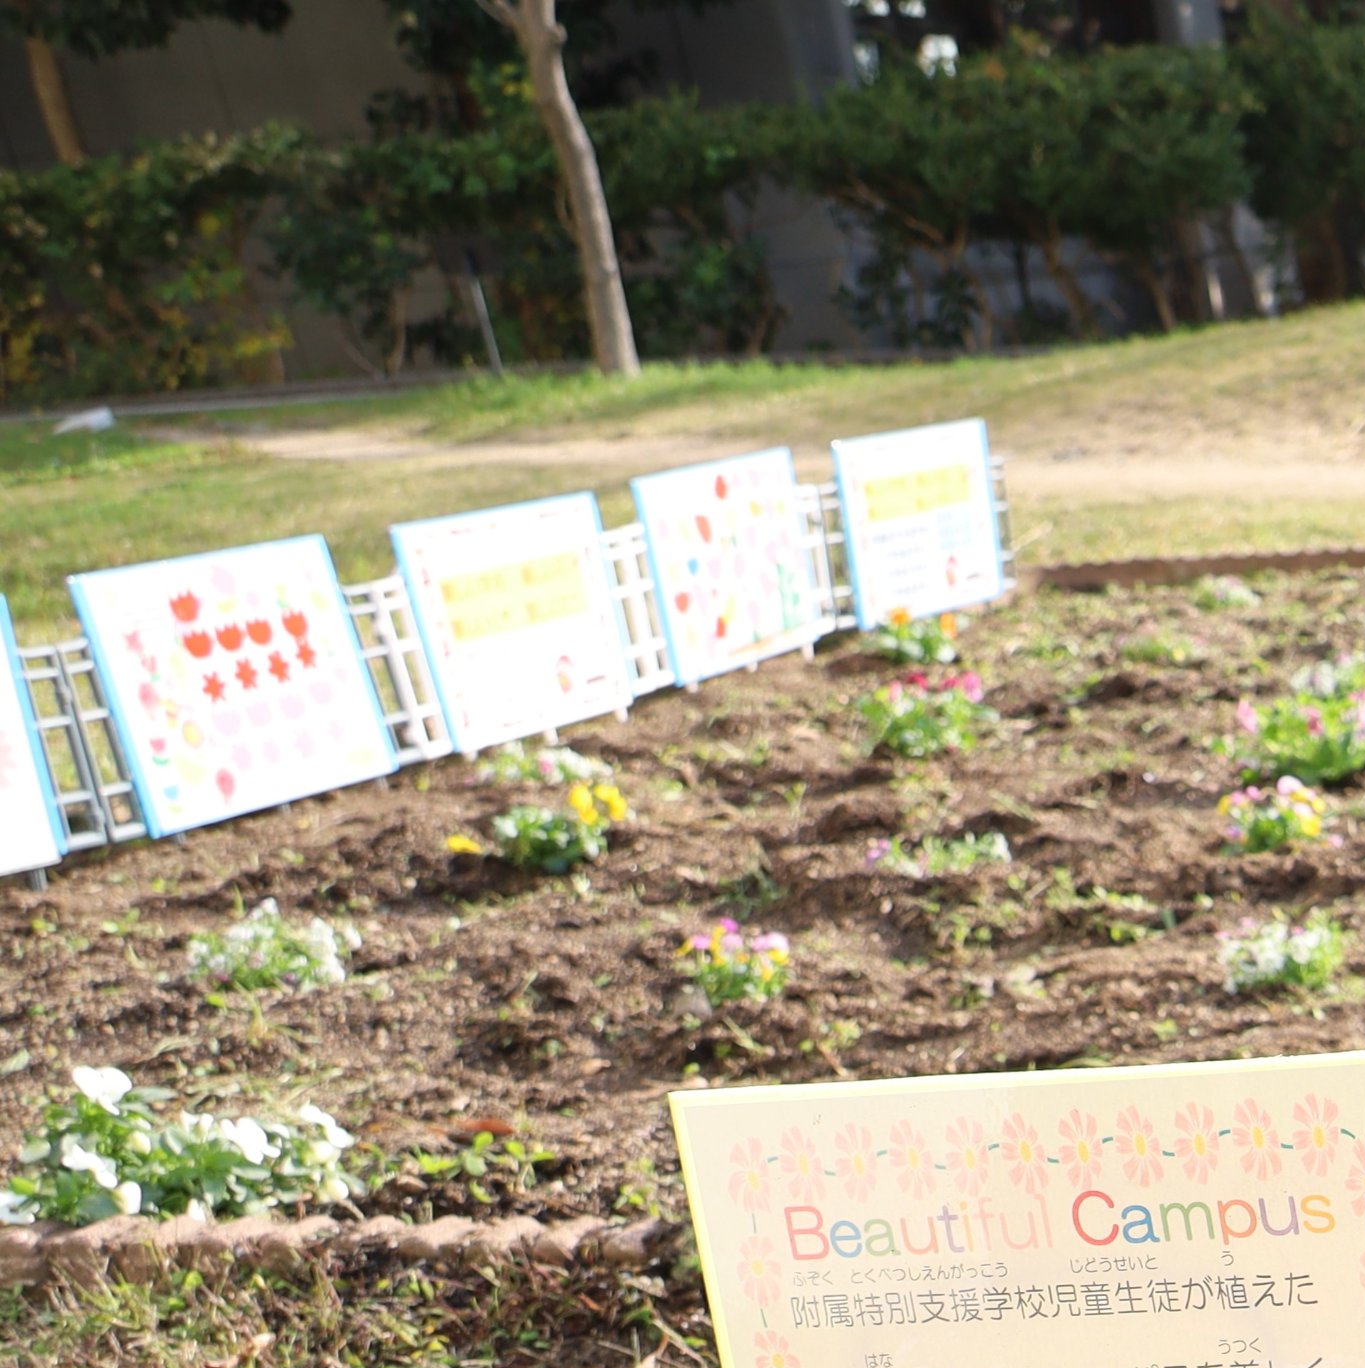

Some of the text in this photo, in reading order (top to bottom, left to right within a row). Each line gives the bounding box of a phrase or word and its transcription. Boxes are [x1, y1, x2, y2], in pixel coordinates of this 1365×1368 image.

[784, 1190, 1336, 1261] Beautiful Campus
[792, 1250, 1235, 1287] ふぞく とくべつしえんがっこう じどうせいと う
[790, 1272, 1319, 1329] 附属特別支援学校児童生徒が植えた
[864, 1337, 1262, 1368] はな うつく
